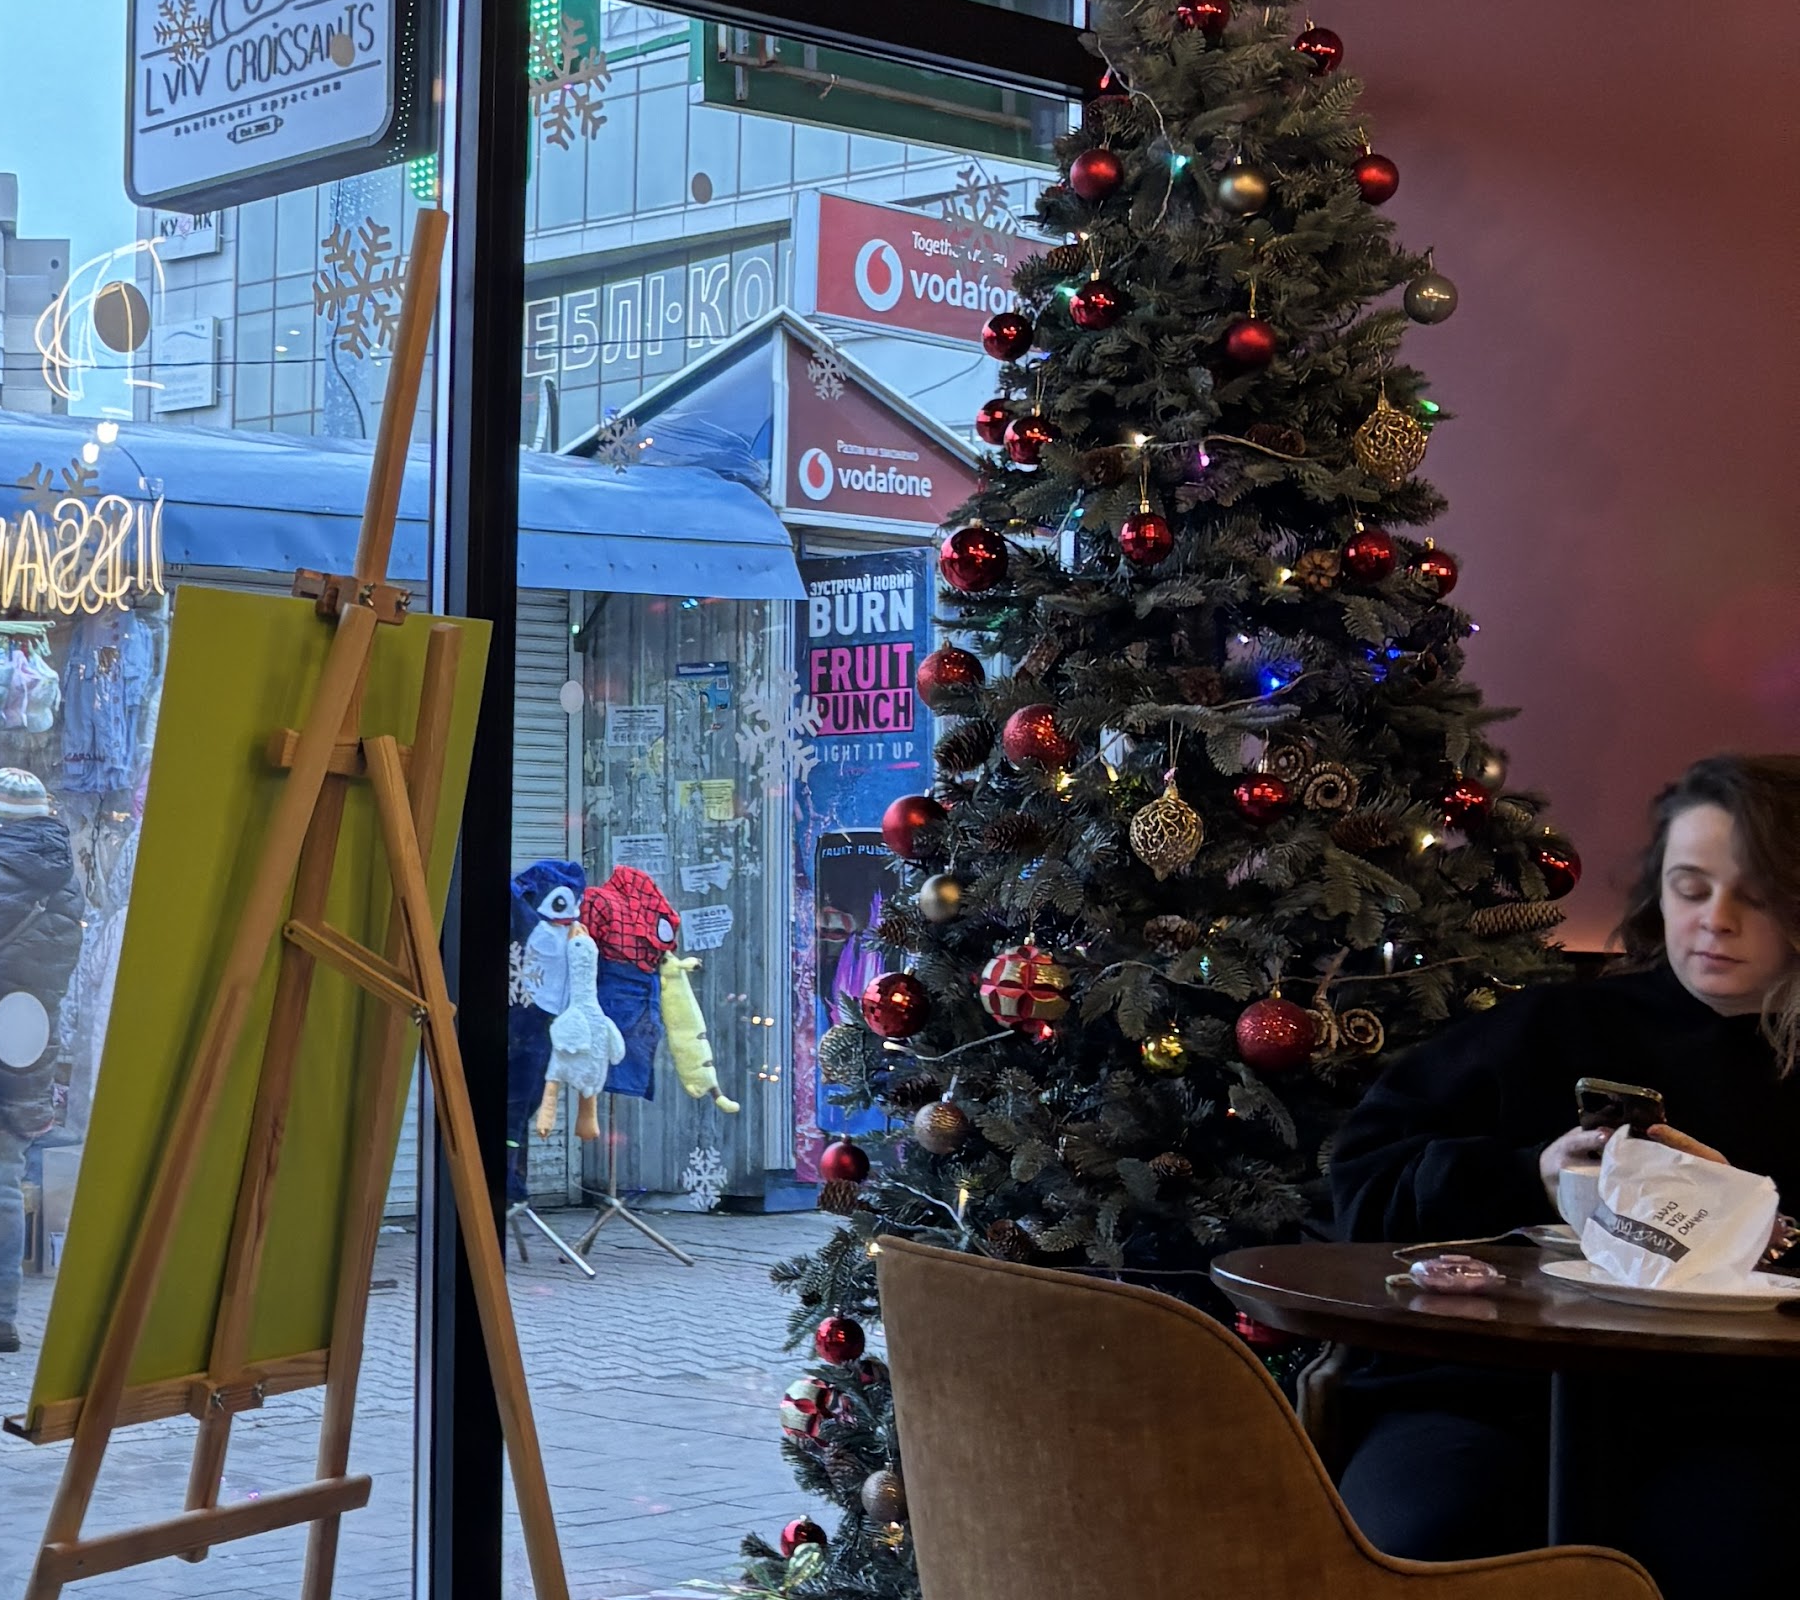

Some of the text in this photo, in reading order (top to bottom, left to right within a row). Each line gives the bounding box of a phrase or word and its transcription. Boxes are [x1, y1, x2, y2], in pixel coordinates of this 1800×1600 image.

[837, 464, 932, 498] vodafone
[810, 569, 914, 597] ЗУСТРІЧАЙ НОВИЙ
[809, 588, 914, 638] BURN
[811, 643, 914, 693] FRUIT
[868, 742, 883, 761] IT
[892, 741, 914, 760] UP
